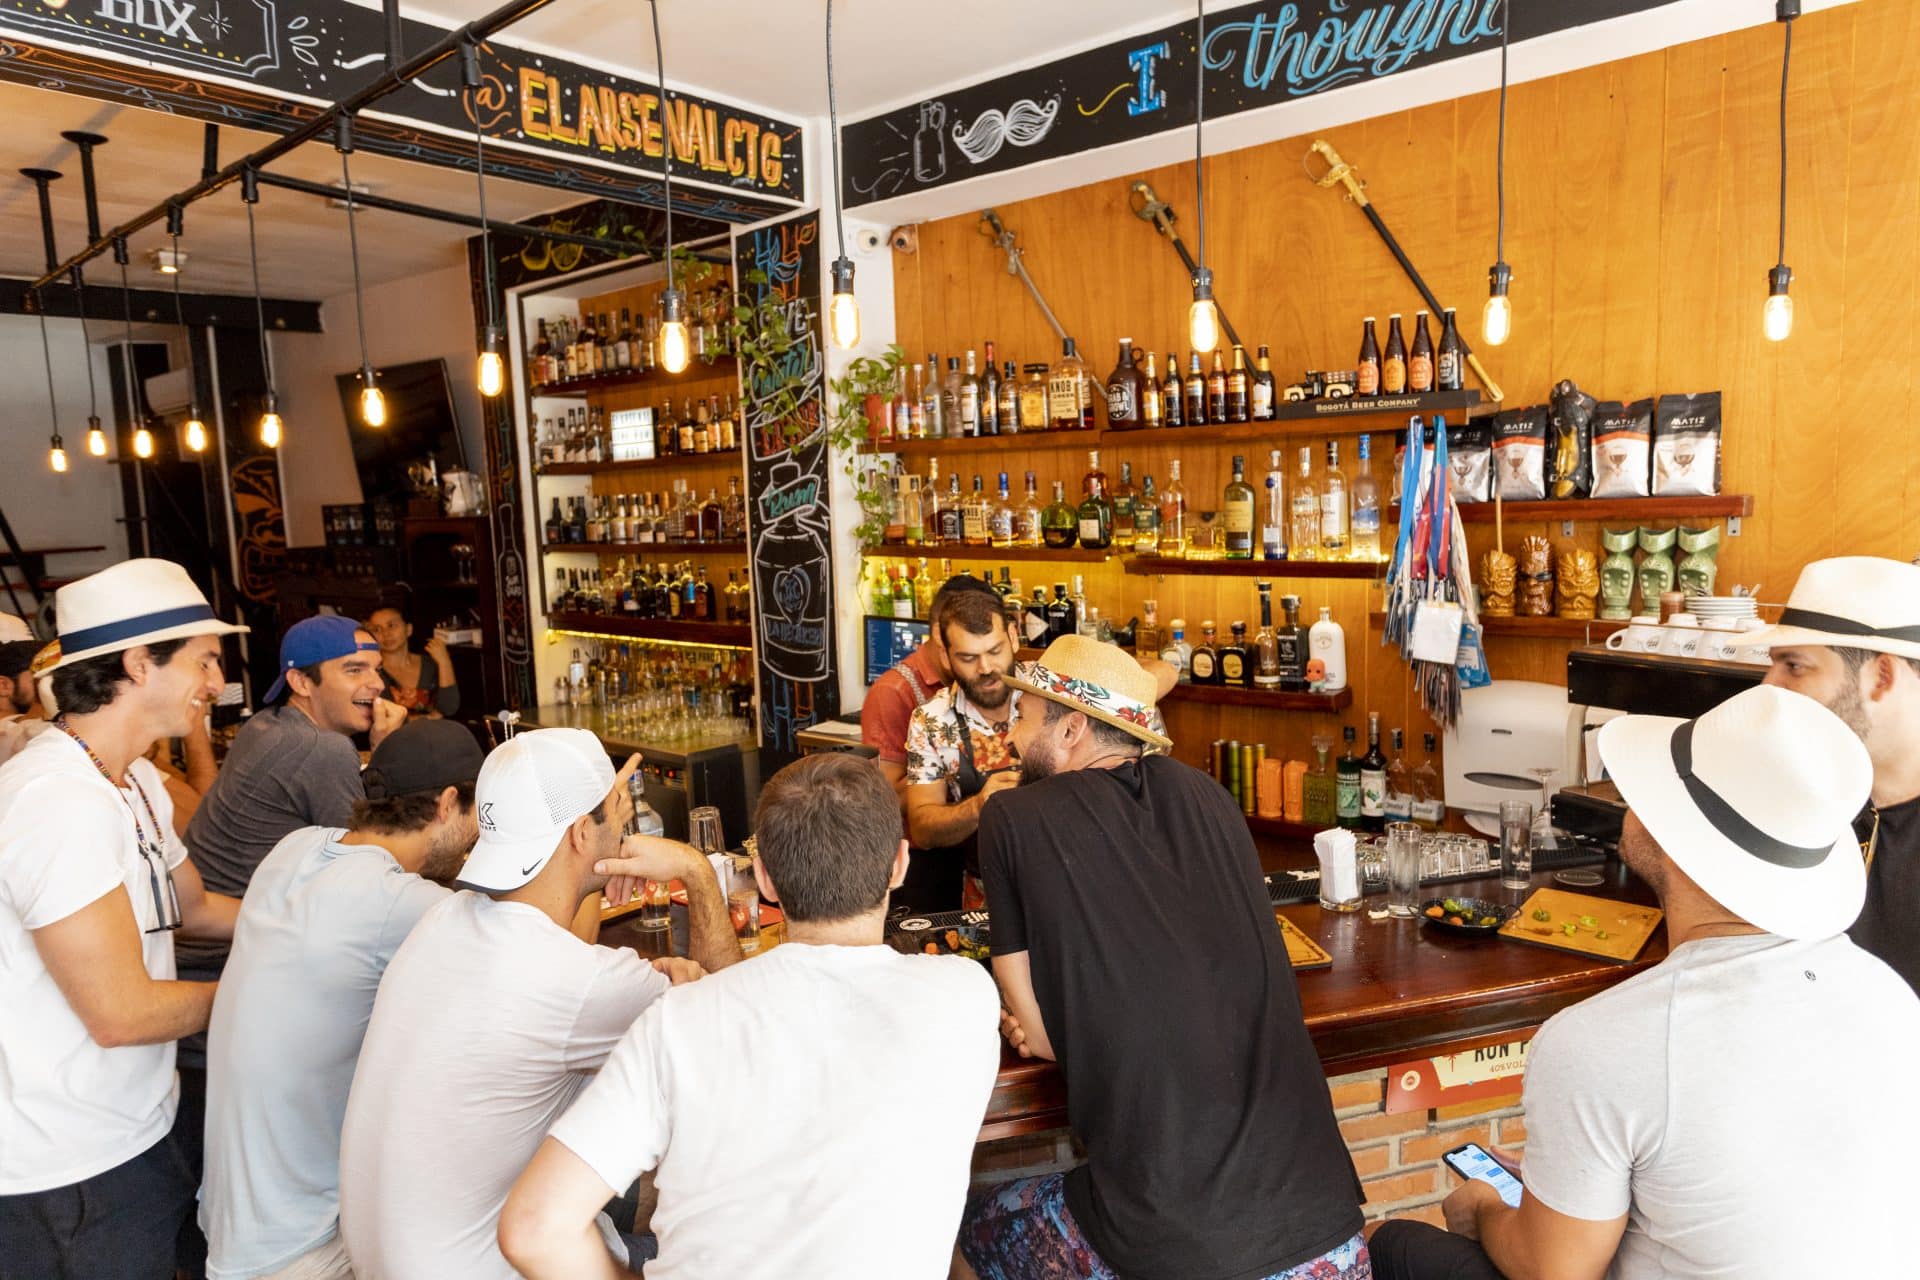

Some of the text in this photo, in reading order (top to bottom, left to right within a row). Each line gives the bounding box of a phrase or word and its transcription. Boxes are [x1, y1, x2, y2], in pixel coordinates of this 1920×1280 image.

[1128, 42, 1170, 117] I
[1050, 380, 1071, 393] KNOB
[1352, 401, 1375, 409] BEER
[1377, 399, 1419, 408] COMPANY
[1671, 416, 1705, 425] MATIZ
[1503, 422, 1534, 431] MATIZ
